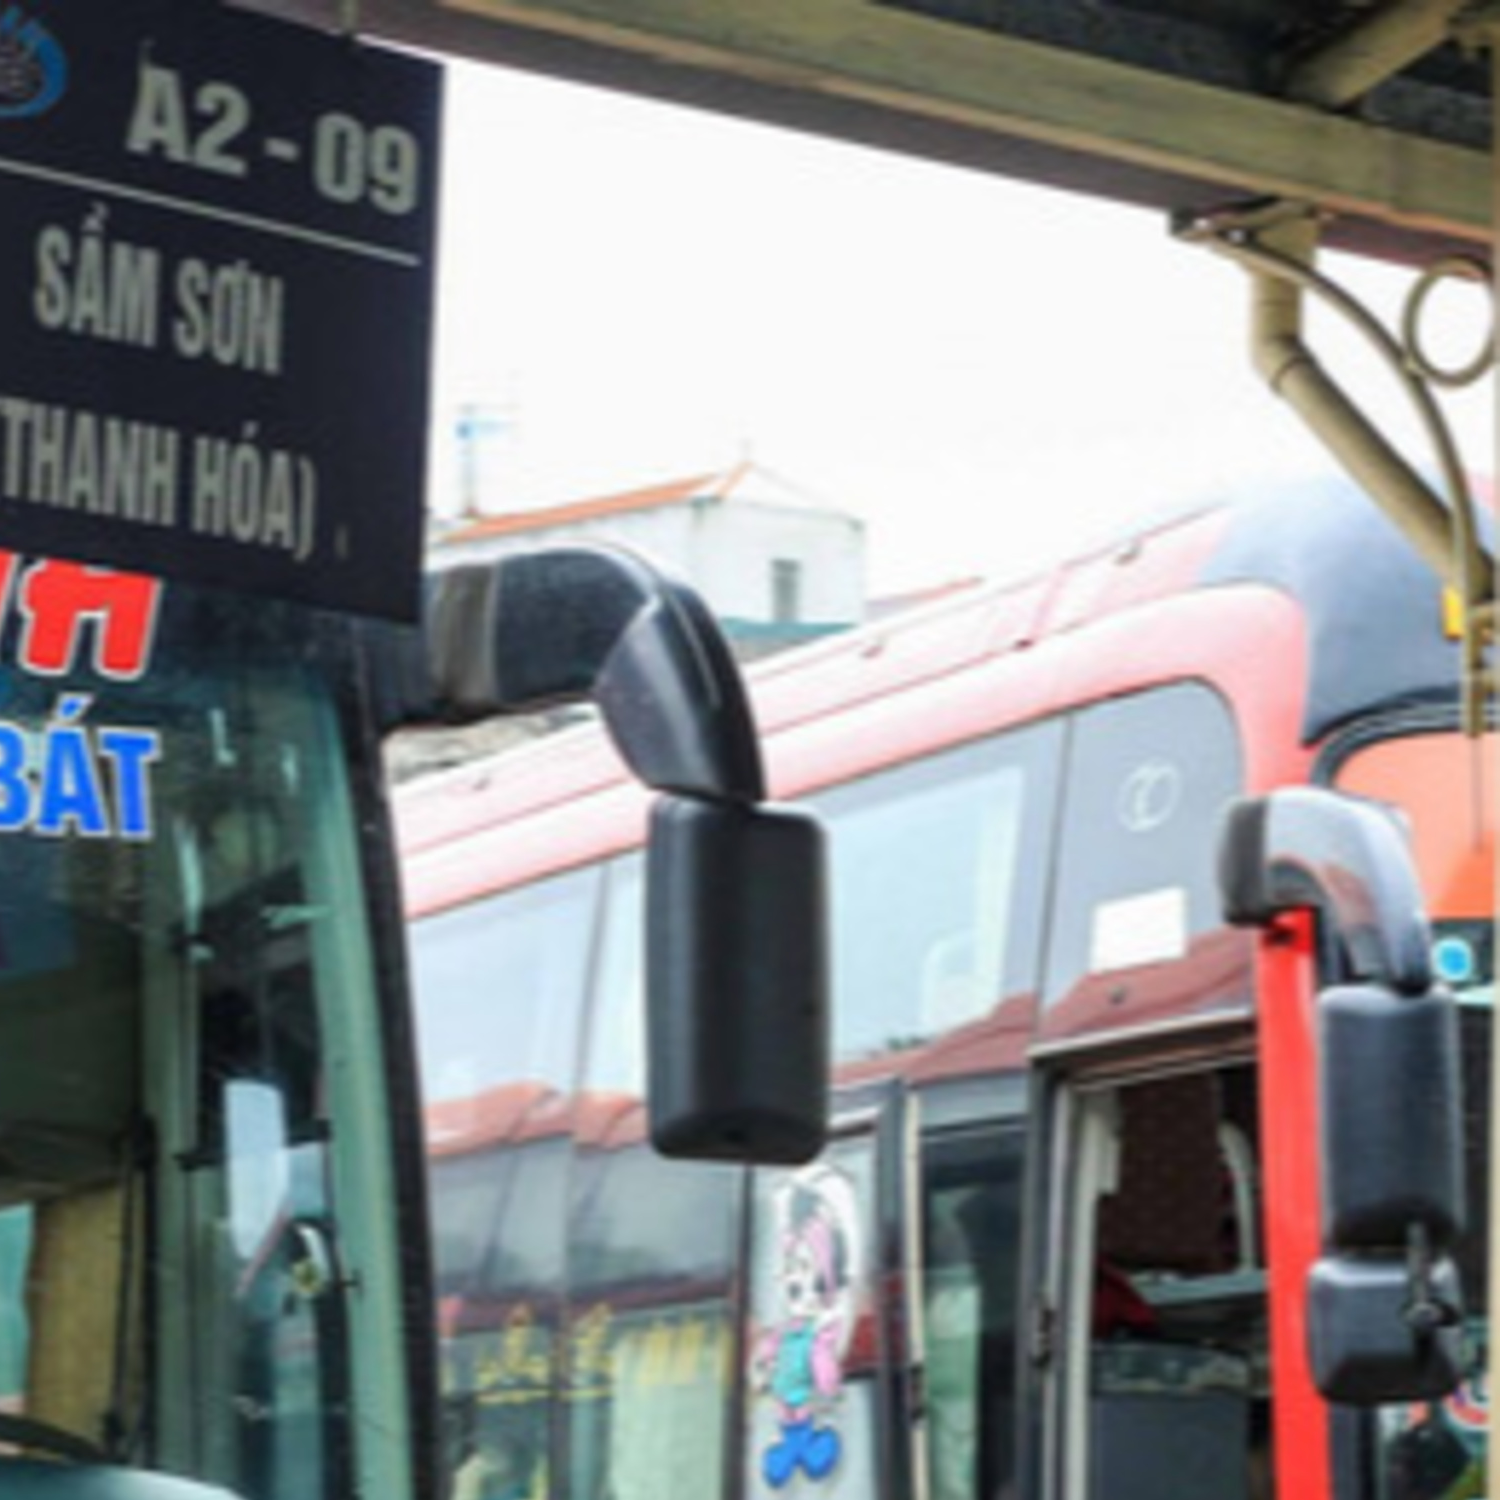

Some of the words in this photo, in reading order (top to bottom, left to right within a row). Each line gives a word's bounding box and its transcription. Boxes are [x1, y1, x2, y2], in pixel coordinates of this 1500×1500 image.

[125, 64, 251, 177] A2
[313, 113, 418, 215] 09
[173, 257, 284, 376] SƠN
[191, 420, 316, 561] HÓA)
